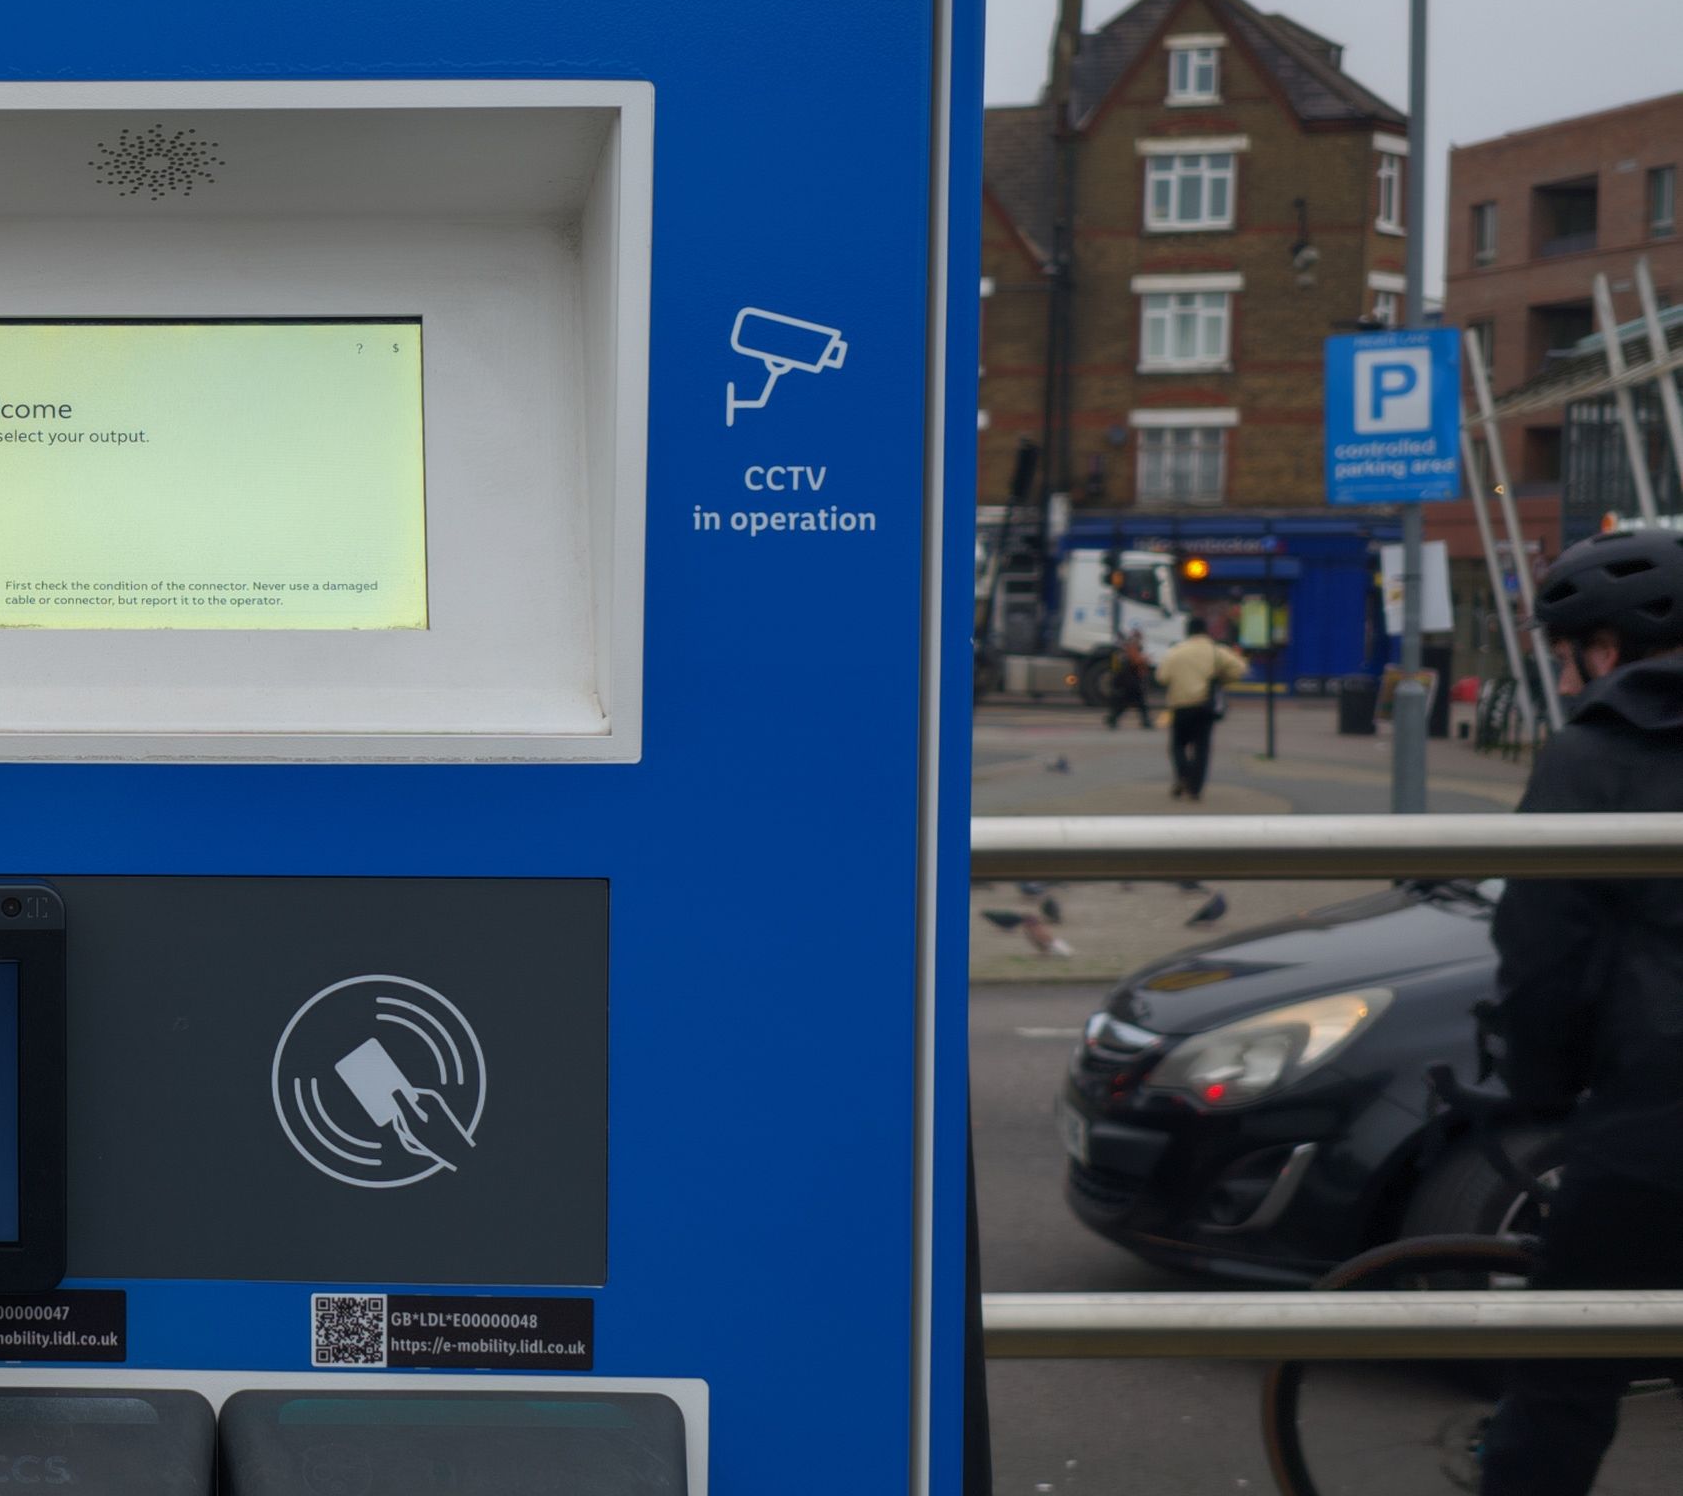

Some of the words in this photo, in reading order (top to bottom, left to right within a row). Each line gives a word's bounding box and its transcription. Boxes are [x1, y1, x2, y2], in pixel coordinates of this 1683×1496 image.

[1372, 363, 1417, 420] P
[49, 433, 84, 445] your
[90, 431, 149, 445] output.
[1335, 438, 1436, 460] controlled
[745, 466, 826, 490] CCTV
[1335, 458, 1407, 481] parking
[1410, 457, 1455, 474] area
[693, 505, 720, 530] in
[731, 506, 875, 537] operation
[6, 581, 31, 590] First
[35, 581, 67, 590] check
[71, 581, 90, 590] the
[93, 581, 147, 590] condition
[151, 581, 163, 590] of
[167, 582, 185, 590] the
[253, 582, 286, 590] Never
[323, 581, 377, 593] damaged
[5, 595, 35, 604] cable
[118, 596, 137, 604] but
[142, 597, 177, 606] report
[181, 596, 188, 605] it
[208, 596, 226, 605] the
[391, 1337, 585, 1355] https://e-mobility.lidl.co.uk
